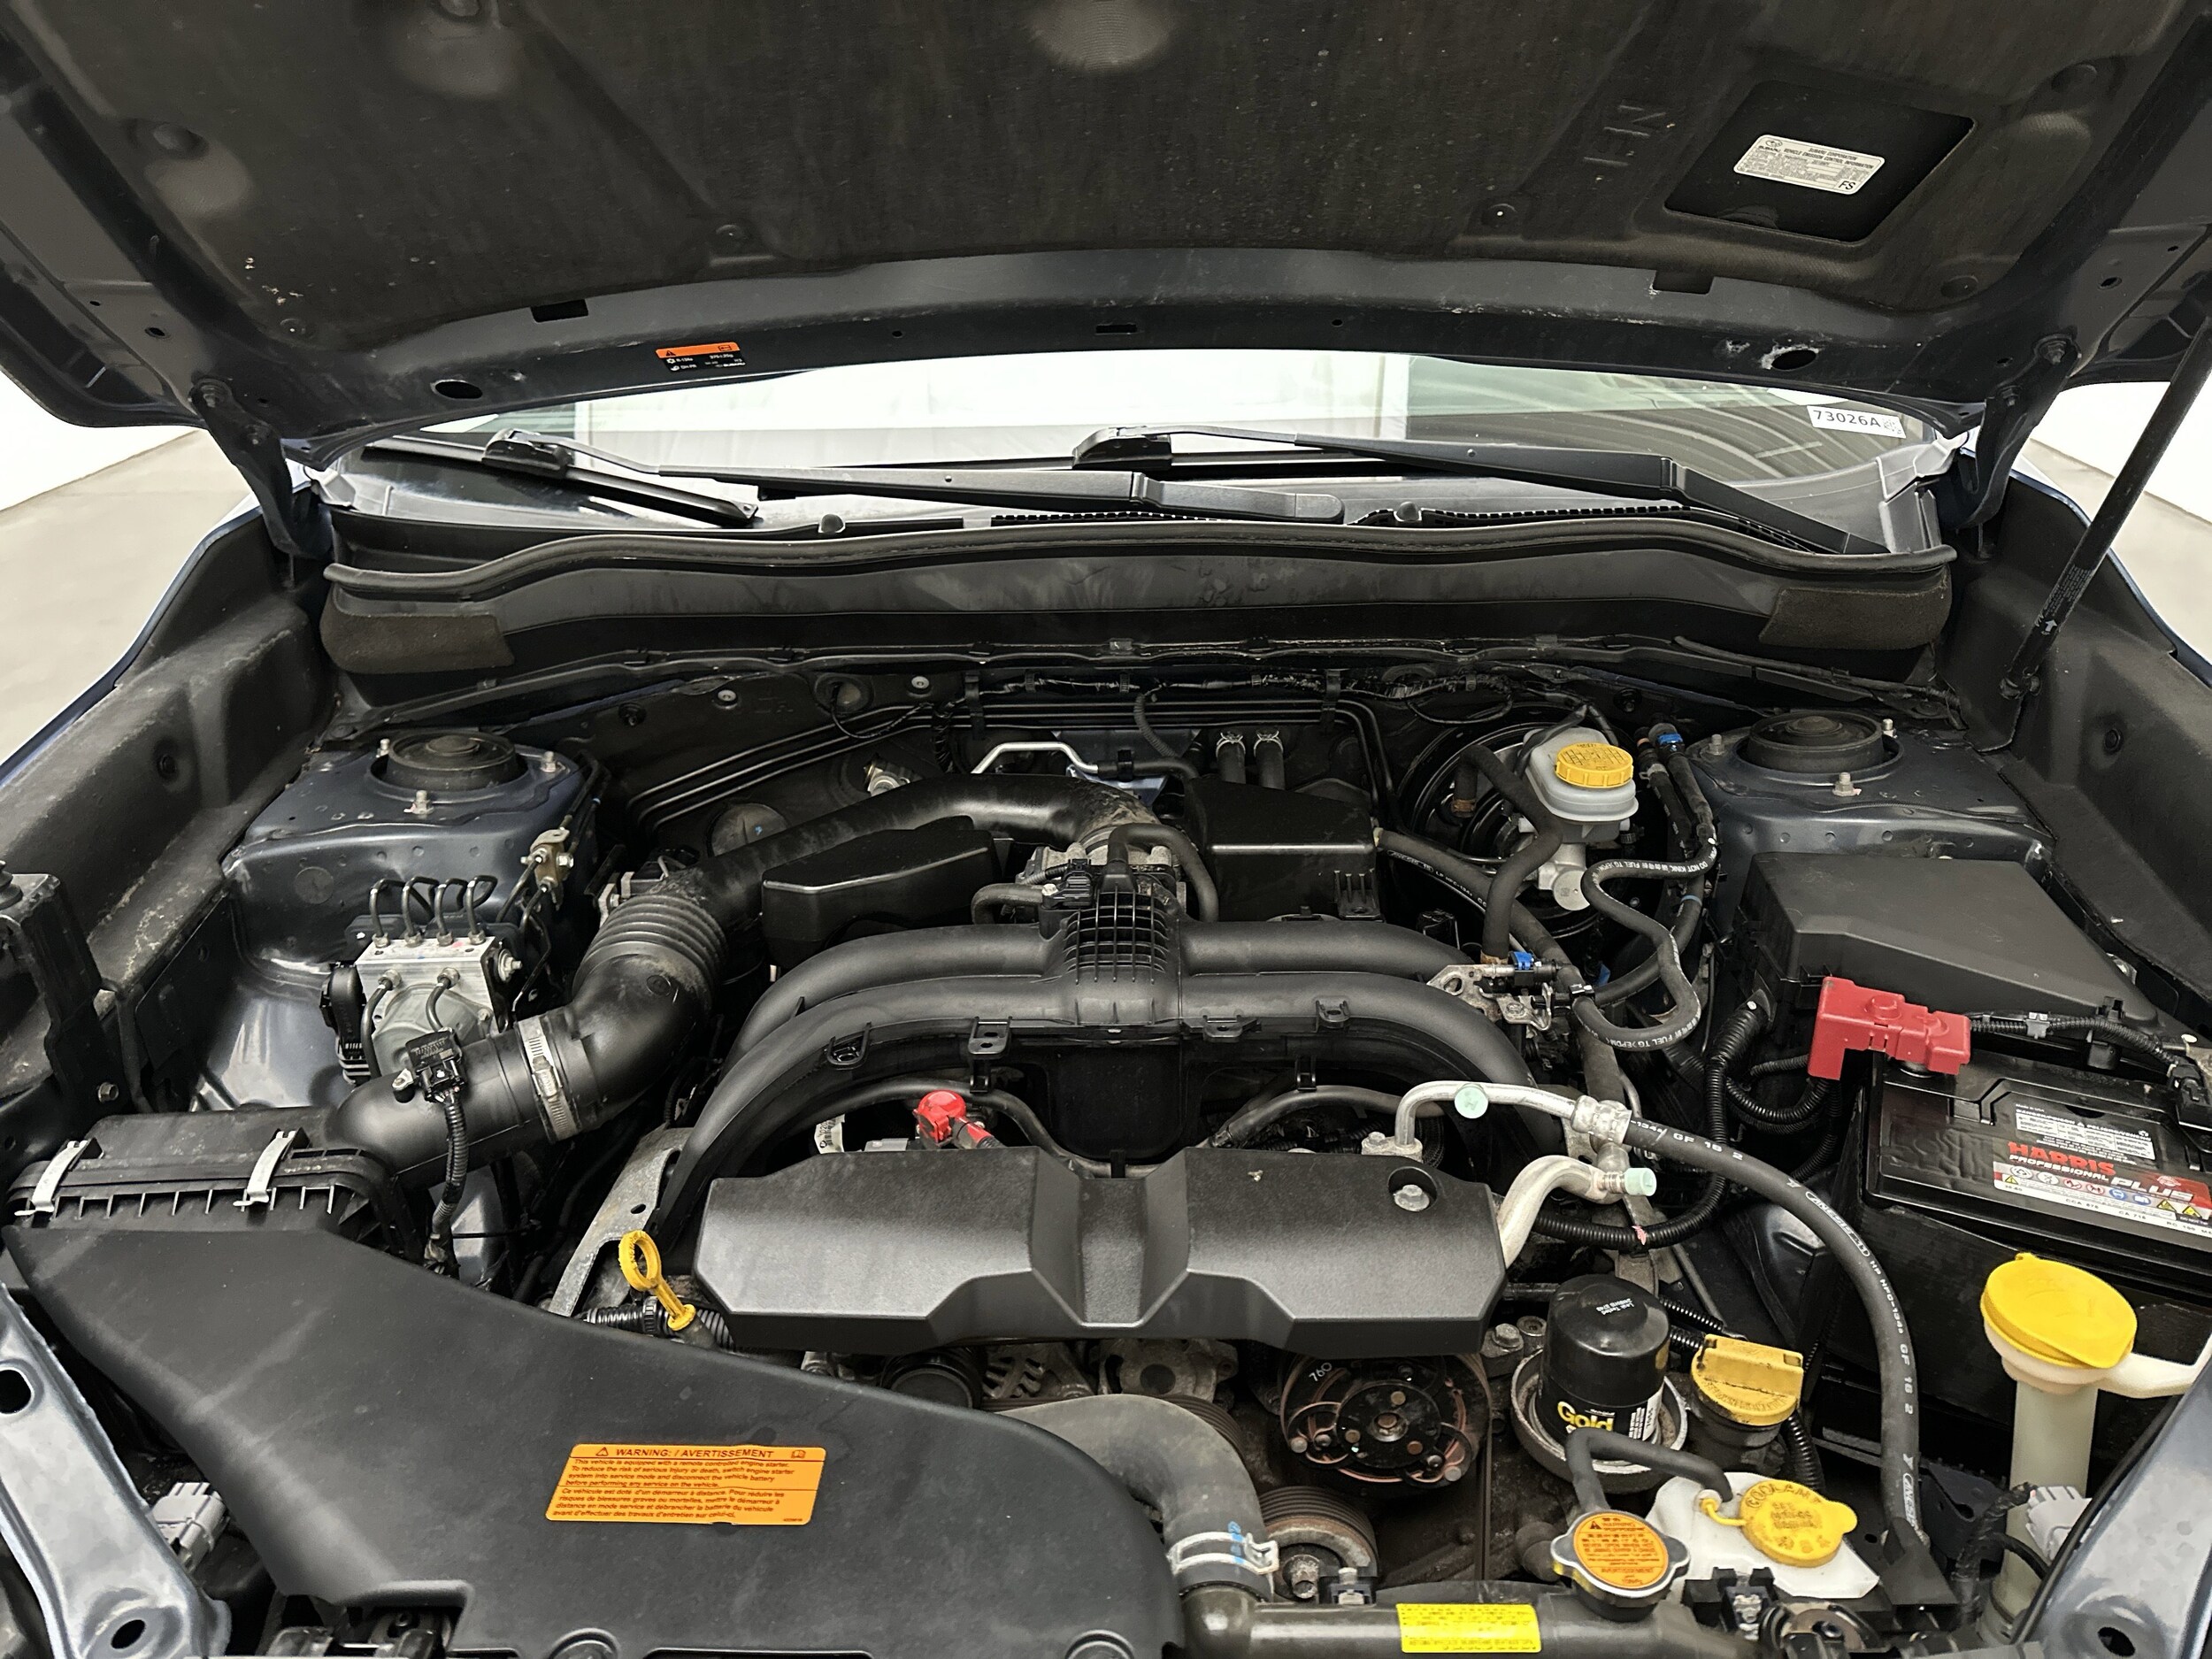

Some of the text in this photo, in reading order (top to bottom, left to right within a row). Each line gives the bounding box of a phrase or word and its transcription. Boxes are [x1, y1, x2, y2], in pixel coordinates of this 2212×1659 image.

[1838, 180, 1856, 190] FS
[1813, 410, 1881, 427] 73026A
[1652, 1033, 1673, 1044] FUEL
[1673, 1133, 1695, 1143] GF
[2008, 1141, 2116, 1176] HARRIS
[2009, 1154, 2109, 1182] PROFESSIONAL
[2109, 1177, 2193, 1202] PLUS
[1870, 1260, 1881, 1275] HP
[1900, 1343, 1910, 1365] GF
[1309, 1363, 1332, 1382] 760
[1557, 1401, 1614, 1432] Gold
[1904, 1402, 1914, 1415] 2
[1745, 1483, 1822, 1509] COOLANT
